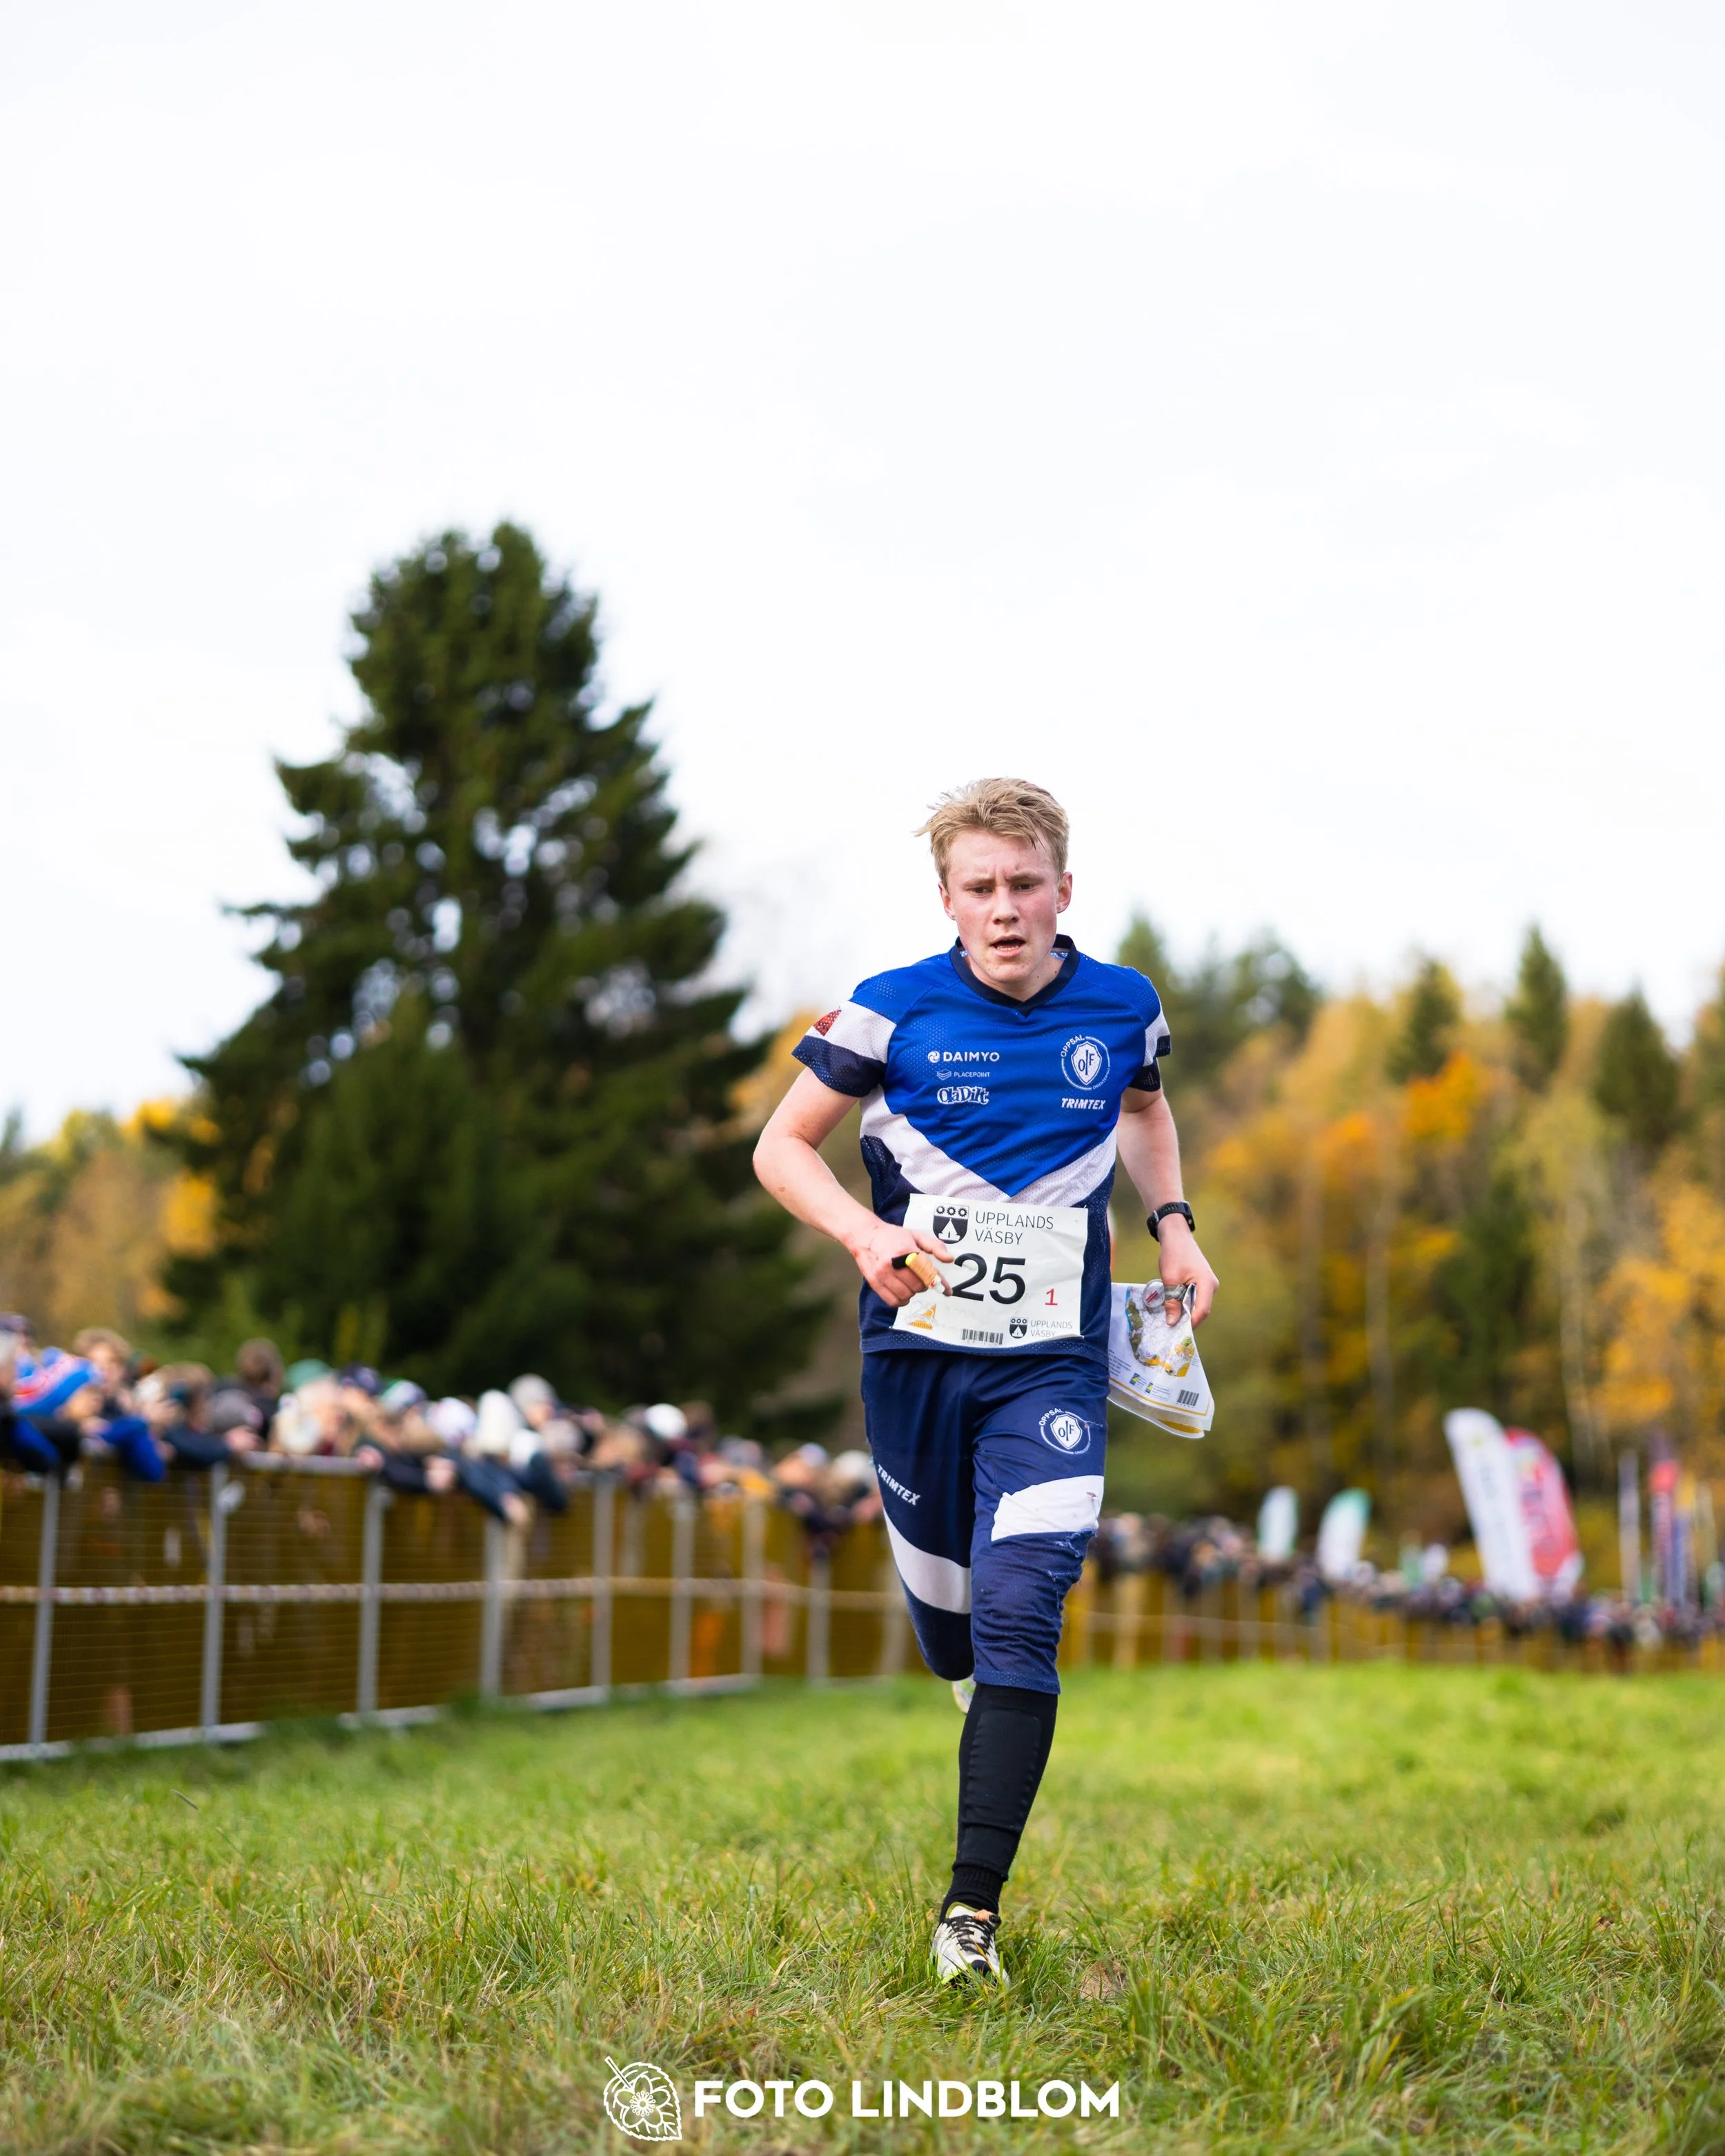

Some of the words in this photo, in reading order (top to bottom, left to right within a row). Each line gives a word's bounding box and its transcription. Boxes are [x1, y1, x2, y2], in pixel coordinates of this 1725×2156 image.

[1061, 1034, 1085, 1057] OPPSAL
[943, 1051, 1000, 1062] DAIMYO
[1061, 1098, 1106, 1109] TRIMTEX
[975, 1211, 1054, 1229] UPPLANDS
[975, 1227, 1023, 1245] VÄSBY
[952, 1252, 1026, 1305] 25
[1045, 1288, 1058, 1306] 1
[1030, 1320, 1073, 1329] UPPLANDS
[878, 1464, 921, 1505] TRIMTEX
